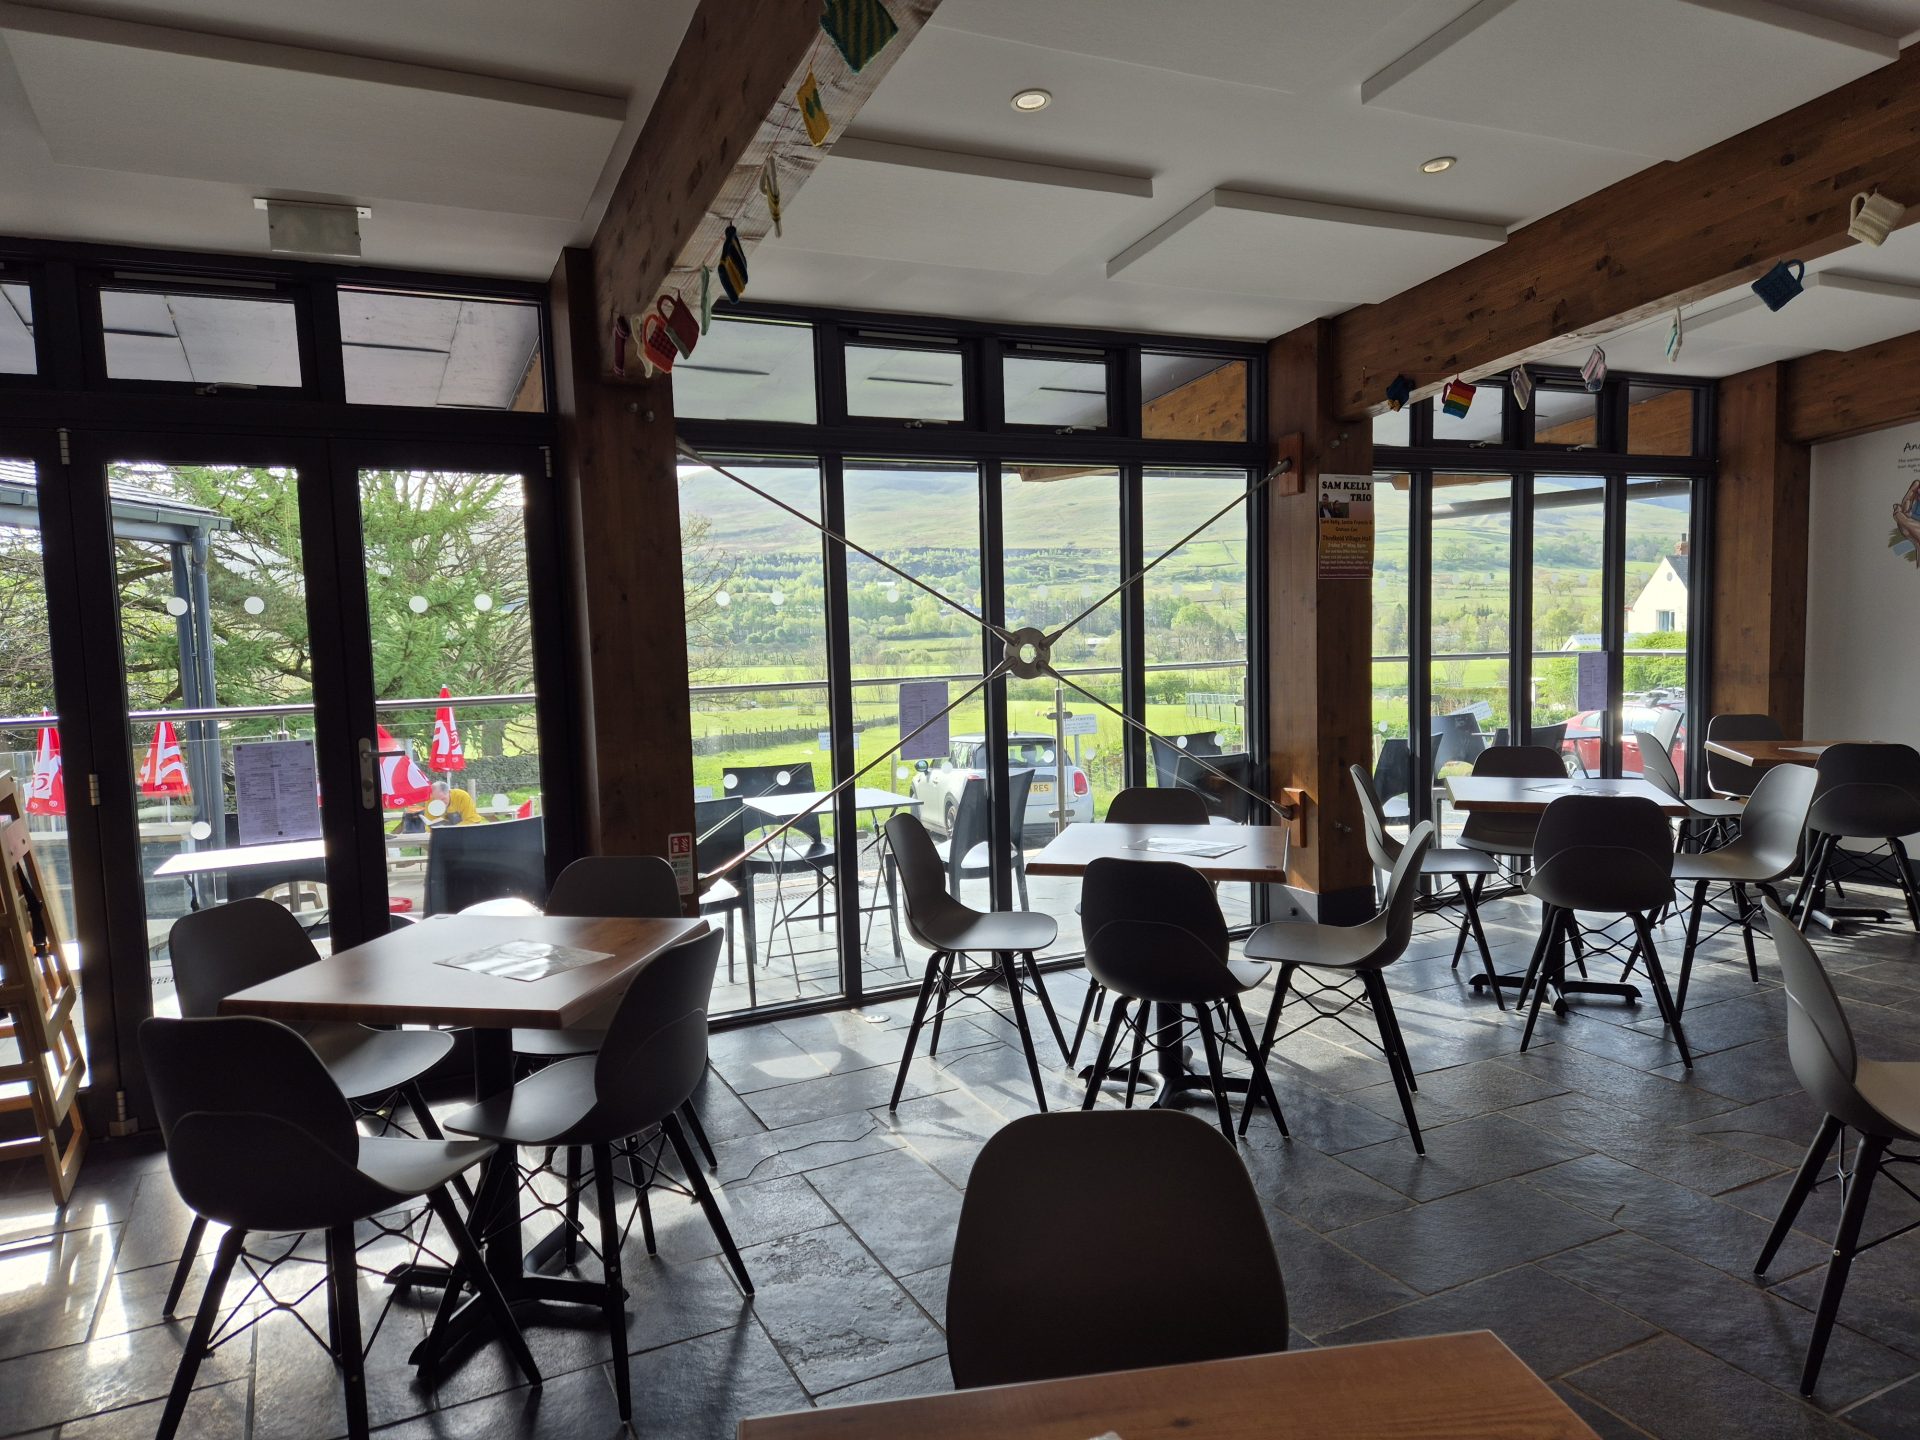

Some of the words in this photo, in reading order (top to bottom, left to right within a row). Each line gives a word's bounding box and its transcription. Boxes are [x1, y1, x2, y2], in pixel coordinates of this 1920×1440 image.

[1322, 481, 1341, 489] SAM
[1343, 481, 1371, 490] KELLY
[1033, 784, 1049, 792] RES
